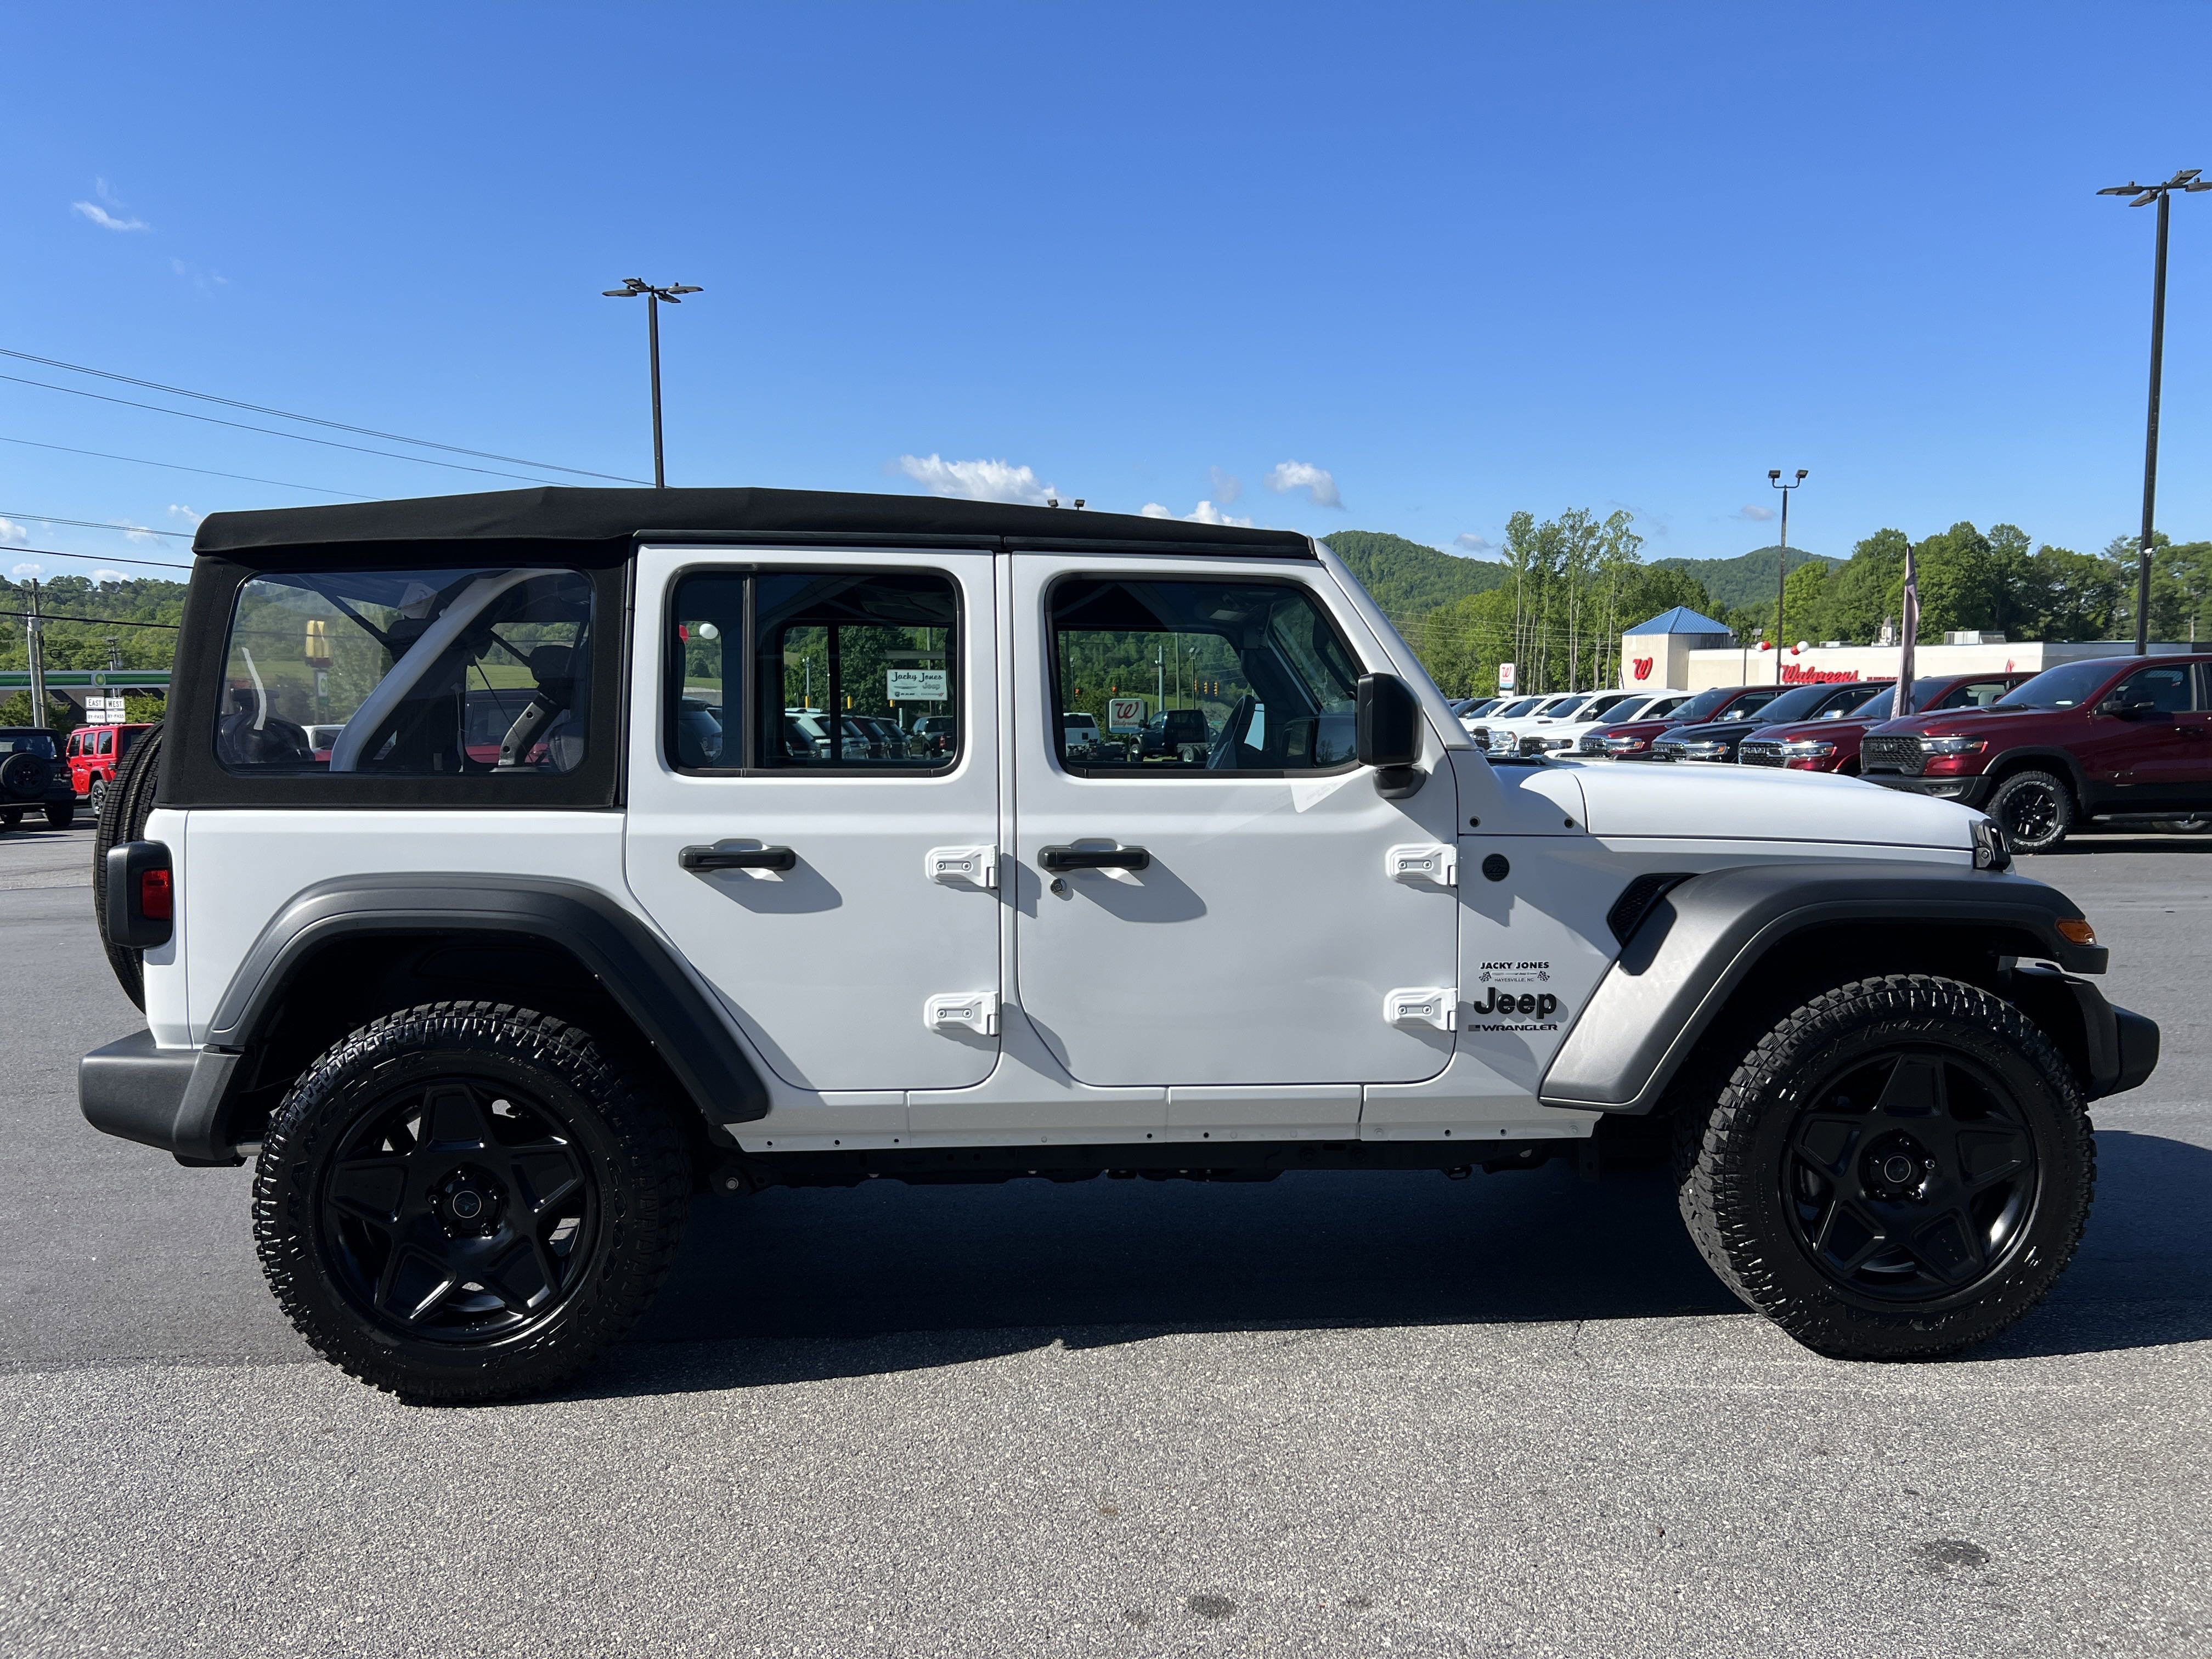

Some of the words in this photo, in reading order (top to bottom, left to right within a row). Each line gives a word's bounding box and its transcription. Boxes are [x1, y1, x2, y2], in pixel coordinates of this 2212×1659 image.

[891, 672, 917, 682] Jacky
[919, 673, 943, 682] Jones
[1781, 663, 1860, 683] Walgreens
[1474, 987, 1557, 1019] Jeep
